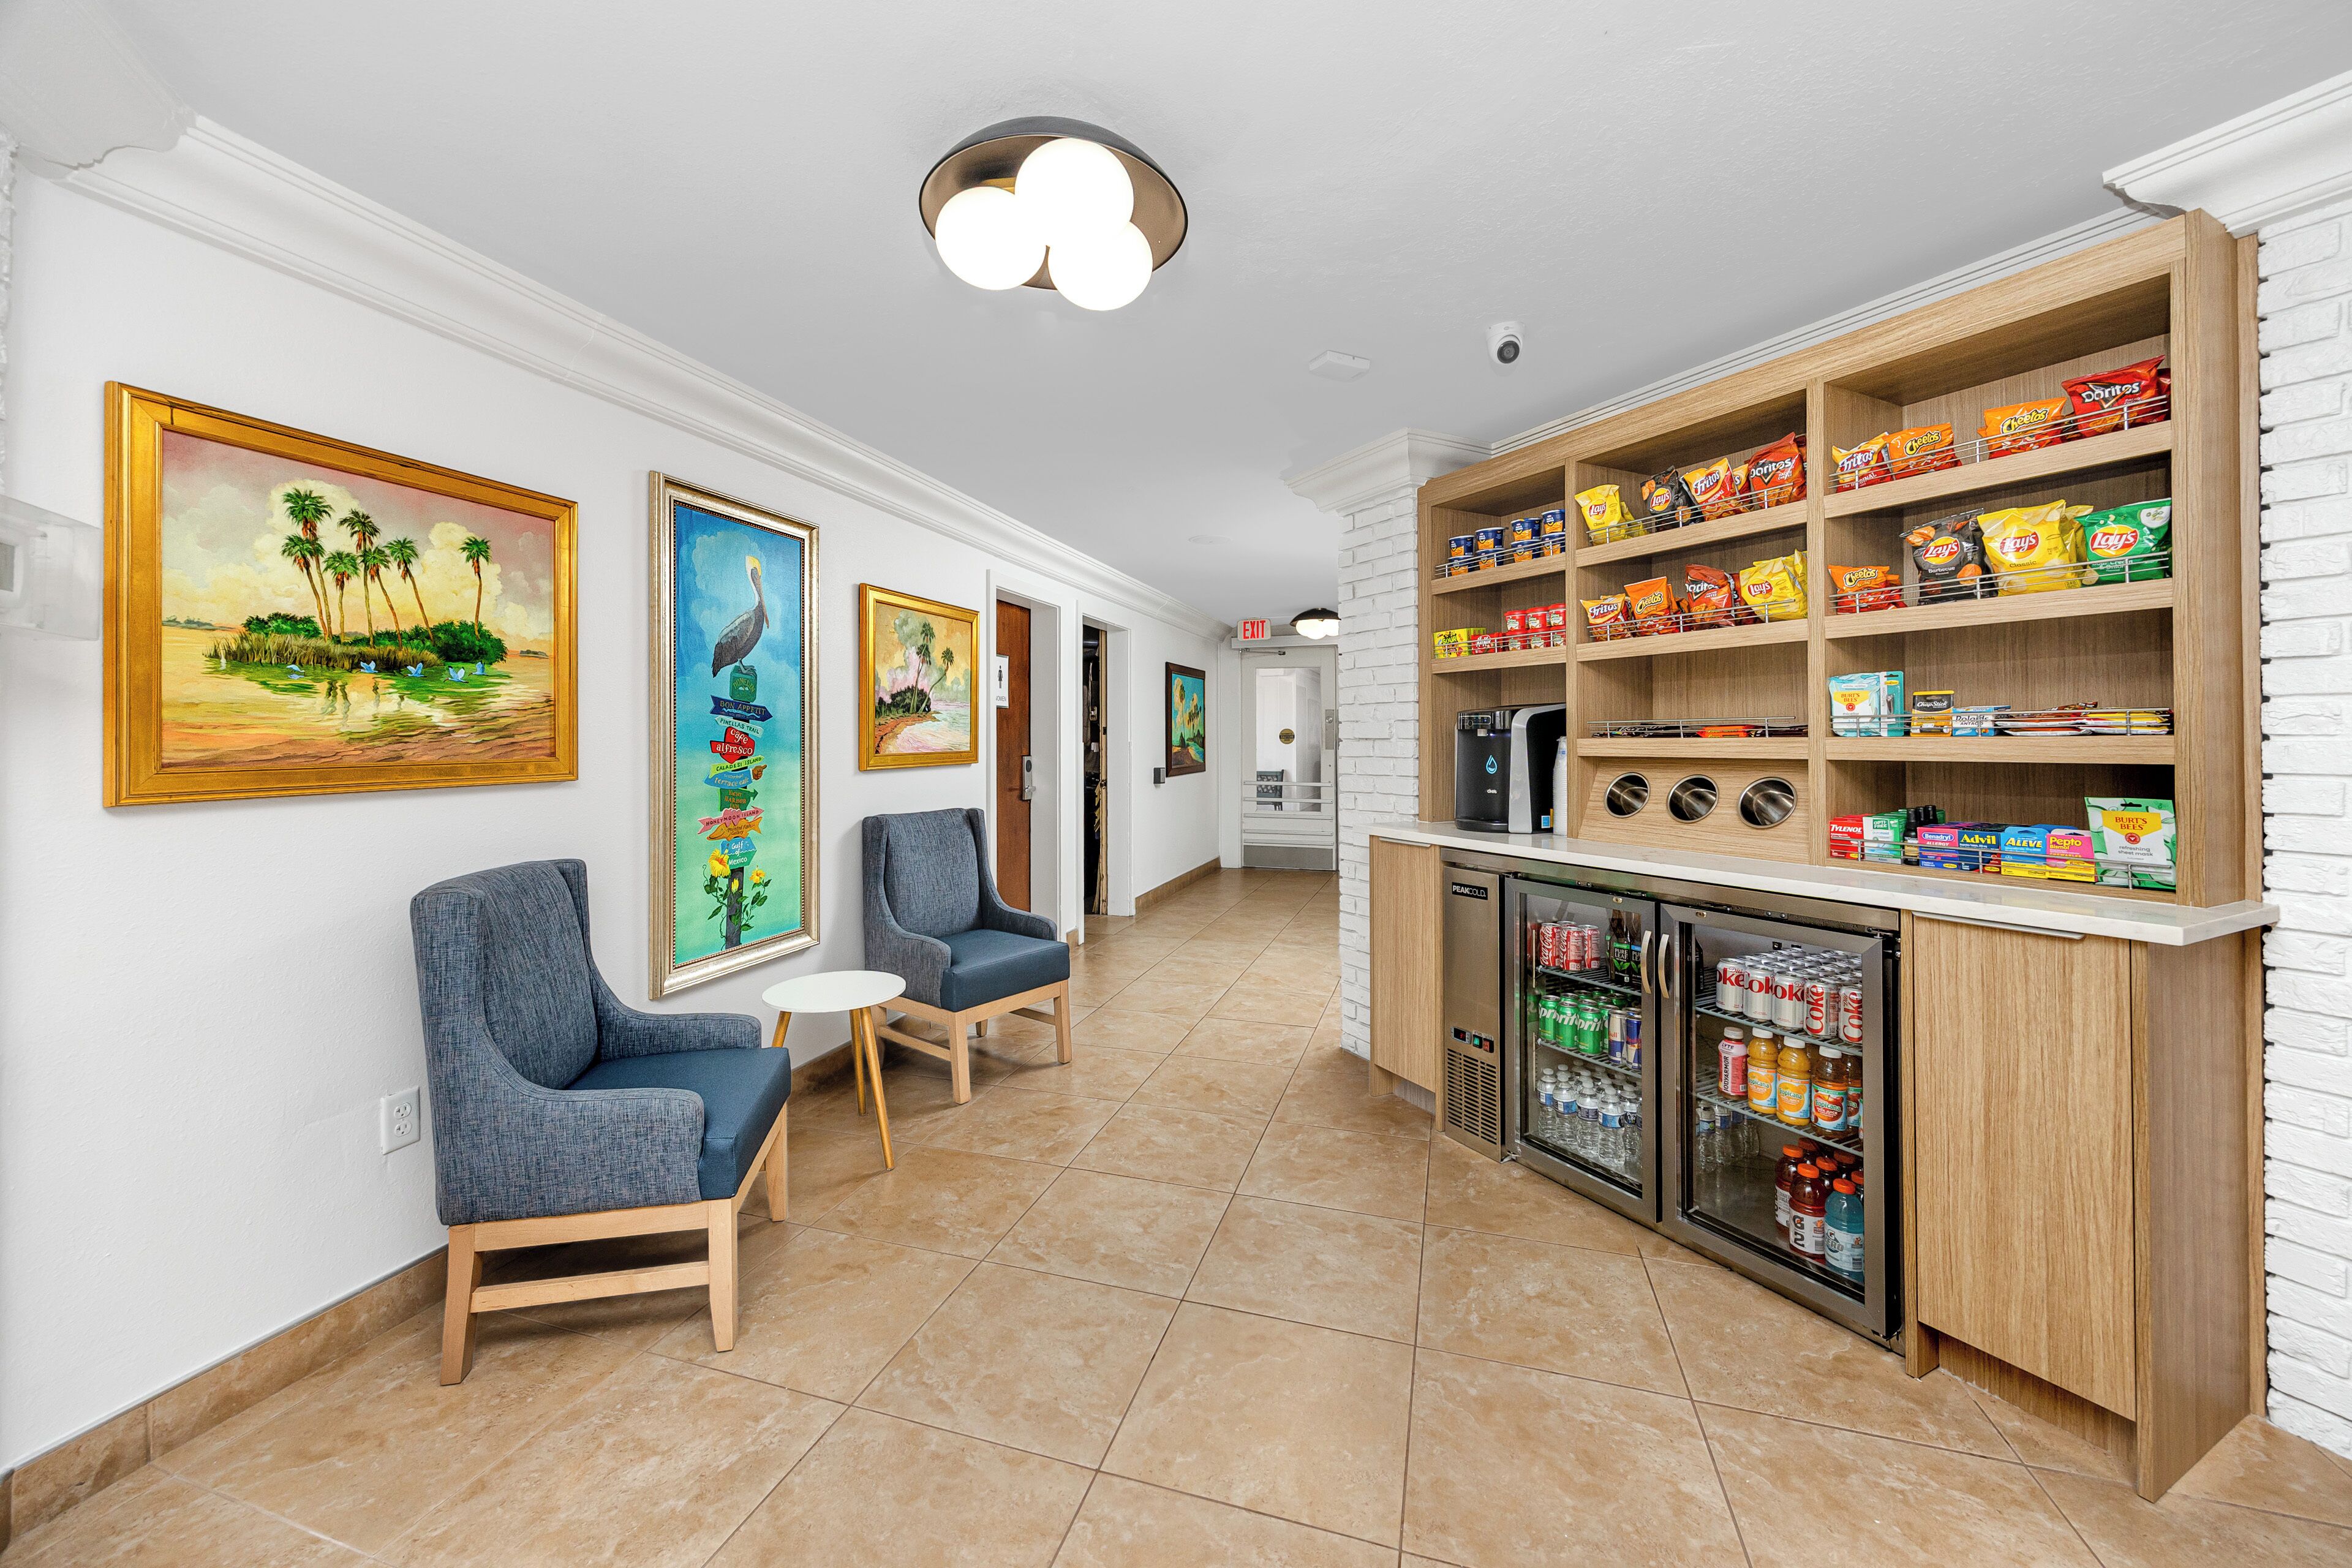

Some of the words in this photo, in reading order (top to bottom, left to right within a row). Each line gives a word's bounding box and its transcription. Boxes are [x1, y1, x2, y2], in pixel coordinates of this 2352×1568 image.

[2082, 382, 2140, 403] Doritos
[2002, 410, 2047, 433] Cheetos
[1905, 432, 1940, 456] Cheetos
[1839, 450, 1874, 471] Fritos
[1693, 470, 1720, 496] Fritos
[1651, 492, 1671, 506] Lay's
[1590, 502, 1607, 515] Lay's
[2002, 531, 2038, 553] Lay's
[2092, 530, 2136, 549] Lay's
[1924, 541, 1959, 557] Lay's
[2010, 560, 2037, 568] Classic
[1845, 568, 1877, 586] Cheetos
[1749, 582, 1771, 595] Lay's
[1637, 594, 1662, 612] Cheetos
[1589, 604, 1618, 618] Fritos
[1243, 620, 1265, 639] EXIT
[1442, 636, 1457, 645] SOUR
[720, 700, 735, 709] BON
[737, 704, 766, 715] APPETIT
[720, 718, 745, 729] PINELLAS
[747, 725, 760, 734] TRAIL
[730, 728, 748, 744] cafe
[716, 742, 753, 755] alfresco
[716, 763, 742, 772] CALADESI
[715, 777, 737, 786] terrace
[706, 814, 741, 827] HONEYMOON
[731, 840, 744, 850] Gulf
[1960, 834, 1996, 844] Advil
[2005, 837, 2042, 848] ALEVE
[2049, 837, 2082, 846] Pepto
[735, 848, 741, 857] of
[728, 857, 748, 865] Mexico
[1806, 985, 1825, 1033] Coke
[1843, 992, 1863, 1042] Coke
[1779, 1088, 1803, 1099] Tropicana
[1815, 1099, 1841, 1112] Tropicana
